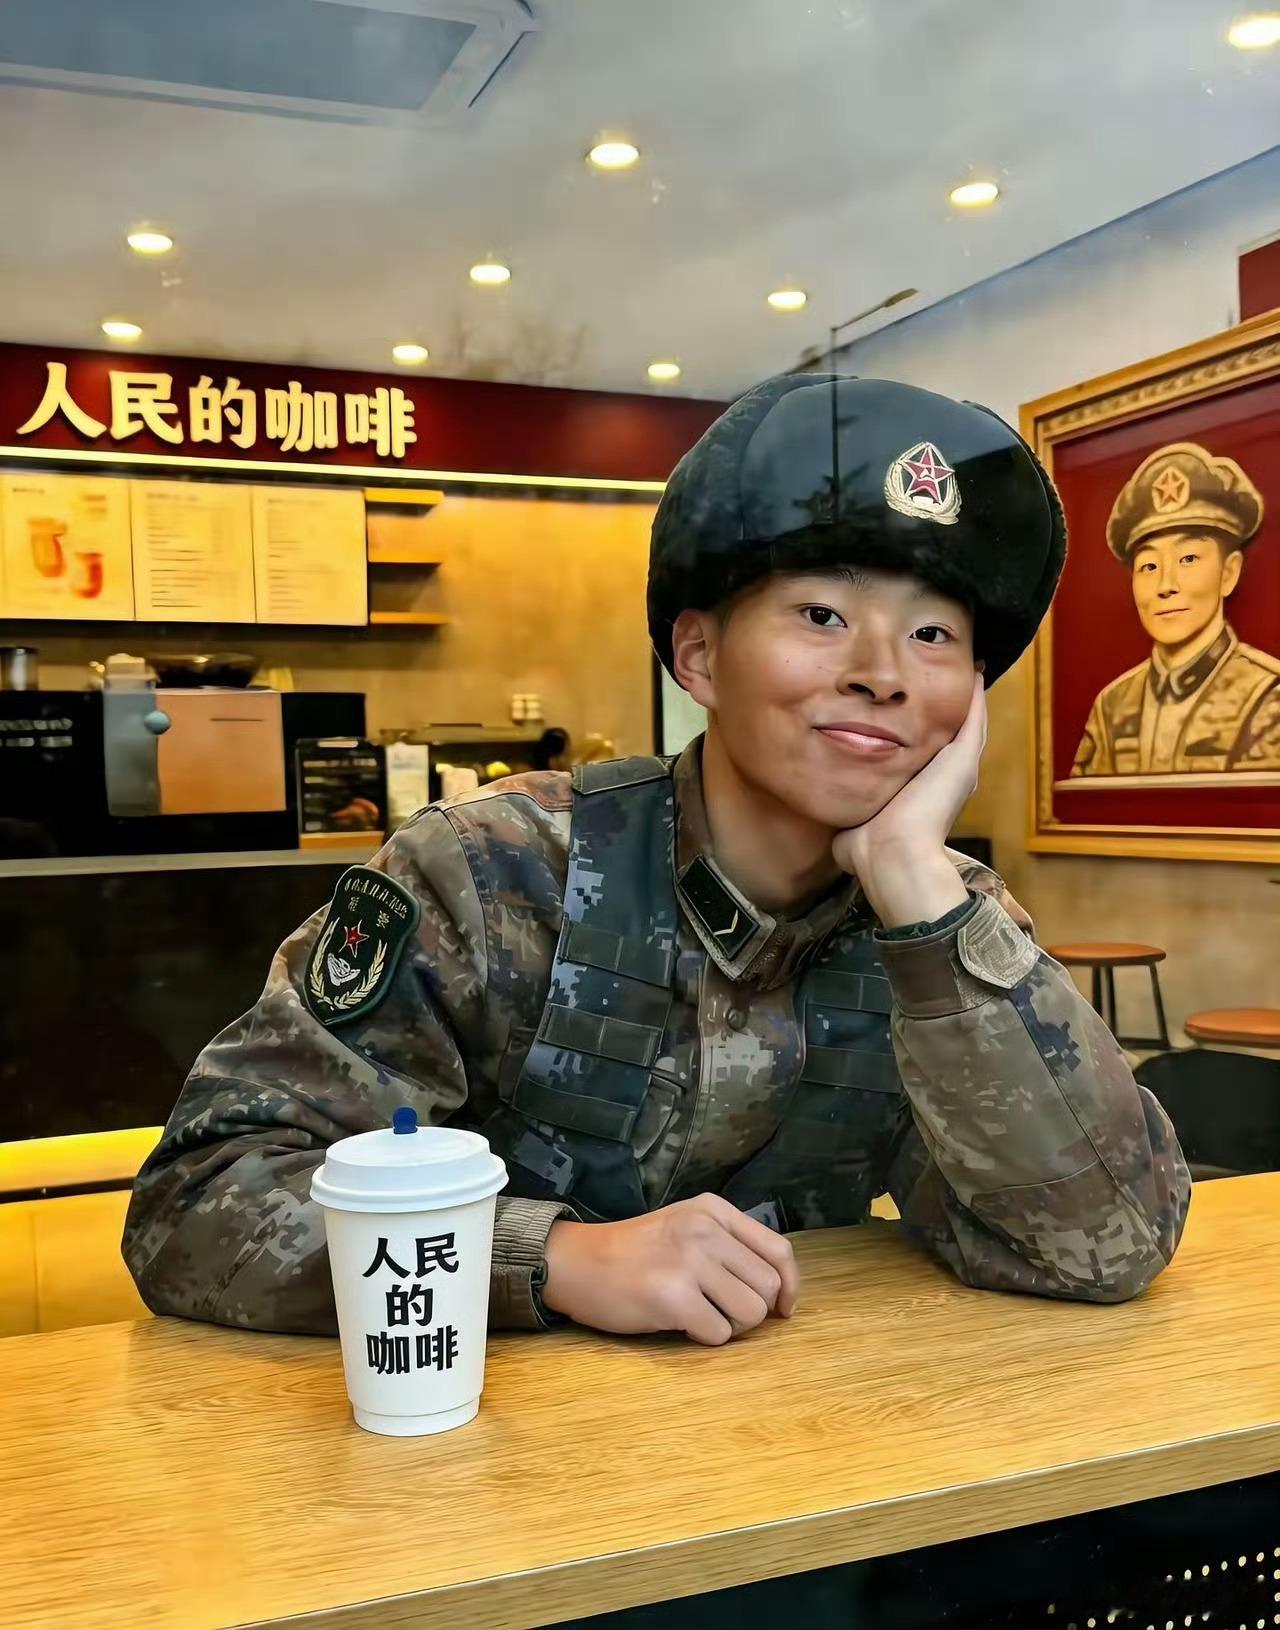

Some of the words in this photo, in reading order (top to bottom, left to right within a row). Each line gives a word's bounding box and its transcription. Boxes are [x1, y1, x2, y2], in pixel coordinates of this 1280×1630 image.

[17, 362, 418, 458] 人民的咖啡
[362, 1232, 459, 1278] 人民
[385, 1284, 434, 1327] 的
[366, 1325, 459, 1375] 咖啡
